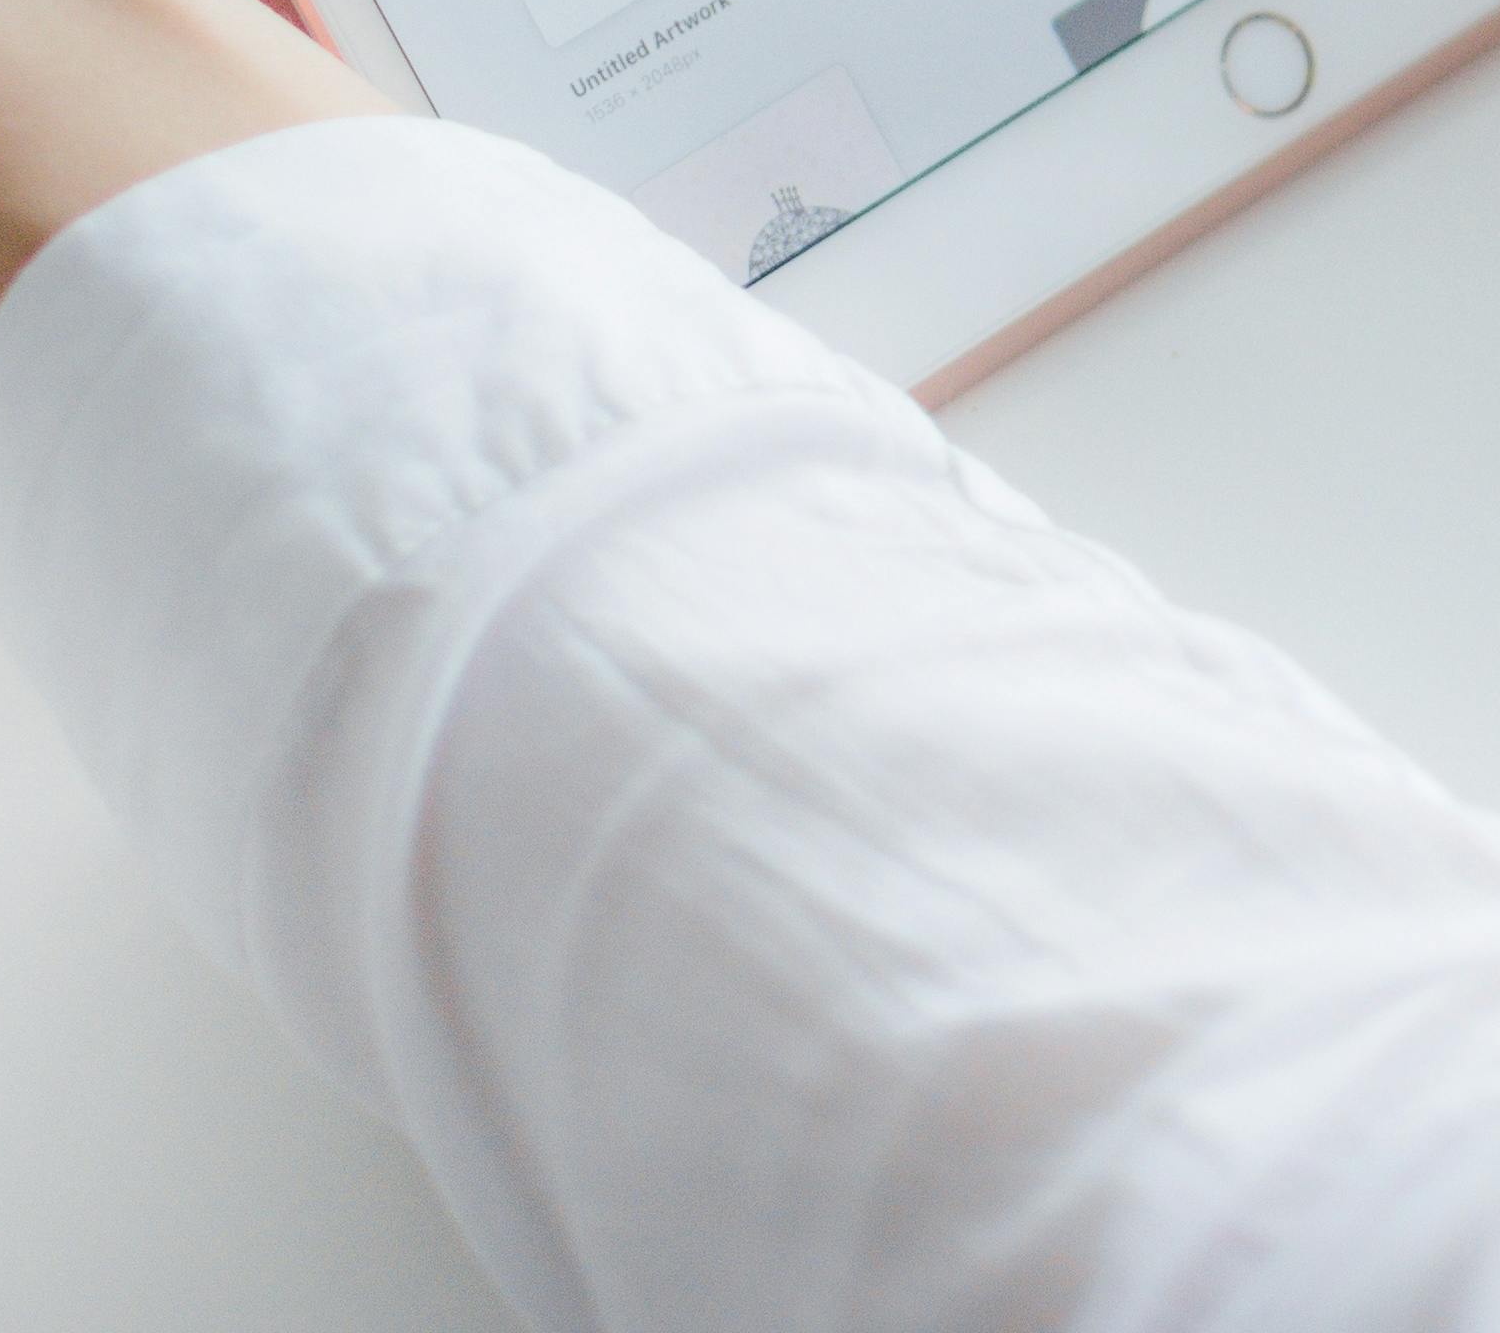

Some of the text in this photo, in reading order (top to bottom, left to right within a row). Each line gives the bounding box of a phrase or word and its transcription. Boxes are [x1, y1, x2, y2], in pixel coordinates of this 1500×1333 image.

[570, 38, 651, 98] Untitled
[585, 91, 627, 123] 1536
[642, 47, 702, 91] 2048px
